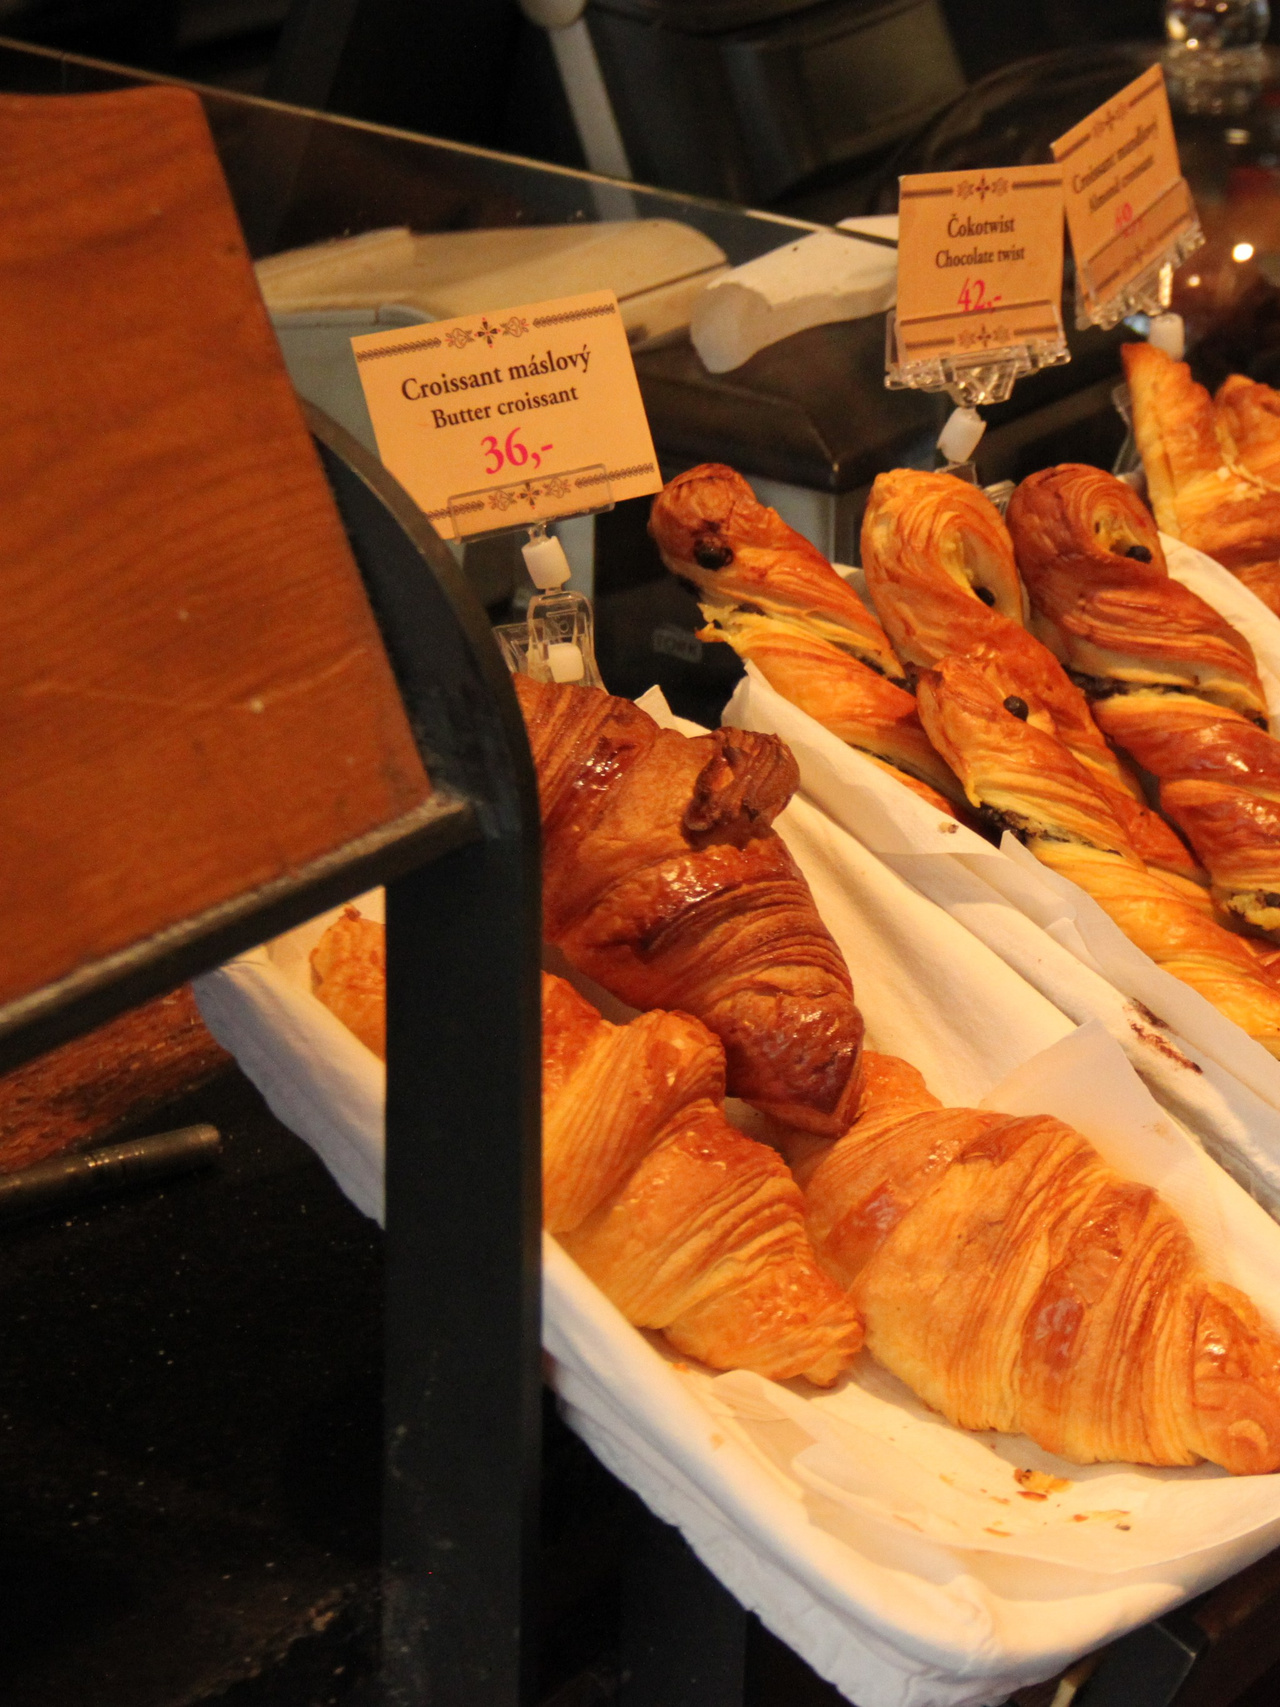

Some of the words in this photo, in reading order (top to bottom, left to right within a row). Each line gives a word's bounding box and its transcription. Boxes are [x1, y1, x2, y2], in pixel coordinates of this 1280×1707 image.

[947, 213, 1015, 238] Čokotwist
[936, 247, 994, 269] Chocolate
[997, 244, 1025, 263] twist
[401, 366, 503, 401] Croissant
[508, 343, 591, 381] máslový
[431, 406, 491, 430] Butter
[497, 386, 579, 416] croissant
[480, 427, 554, 475] 36,-
